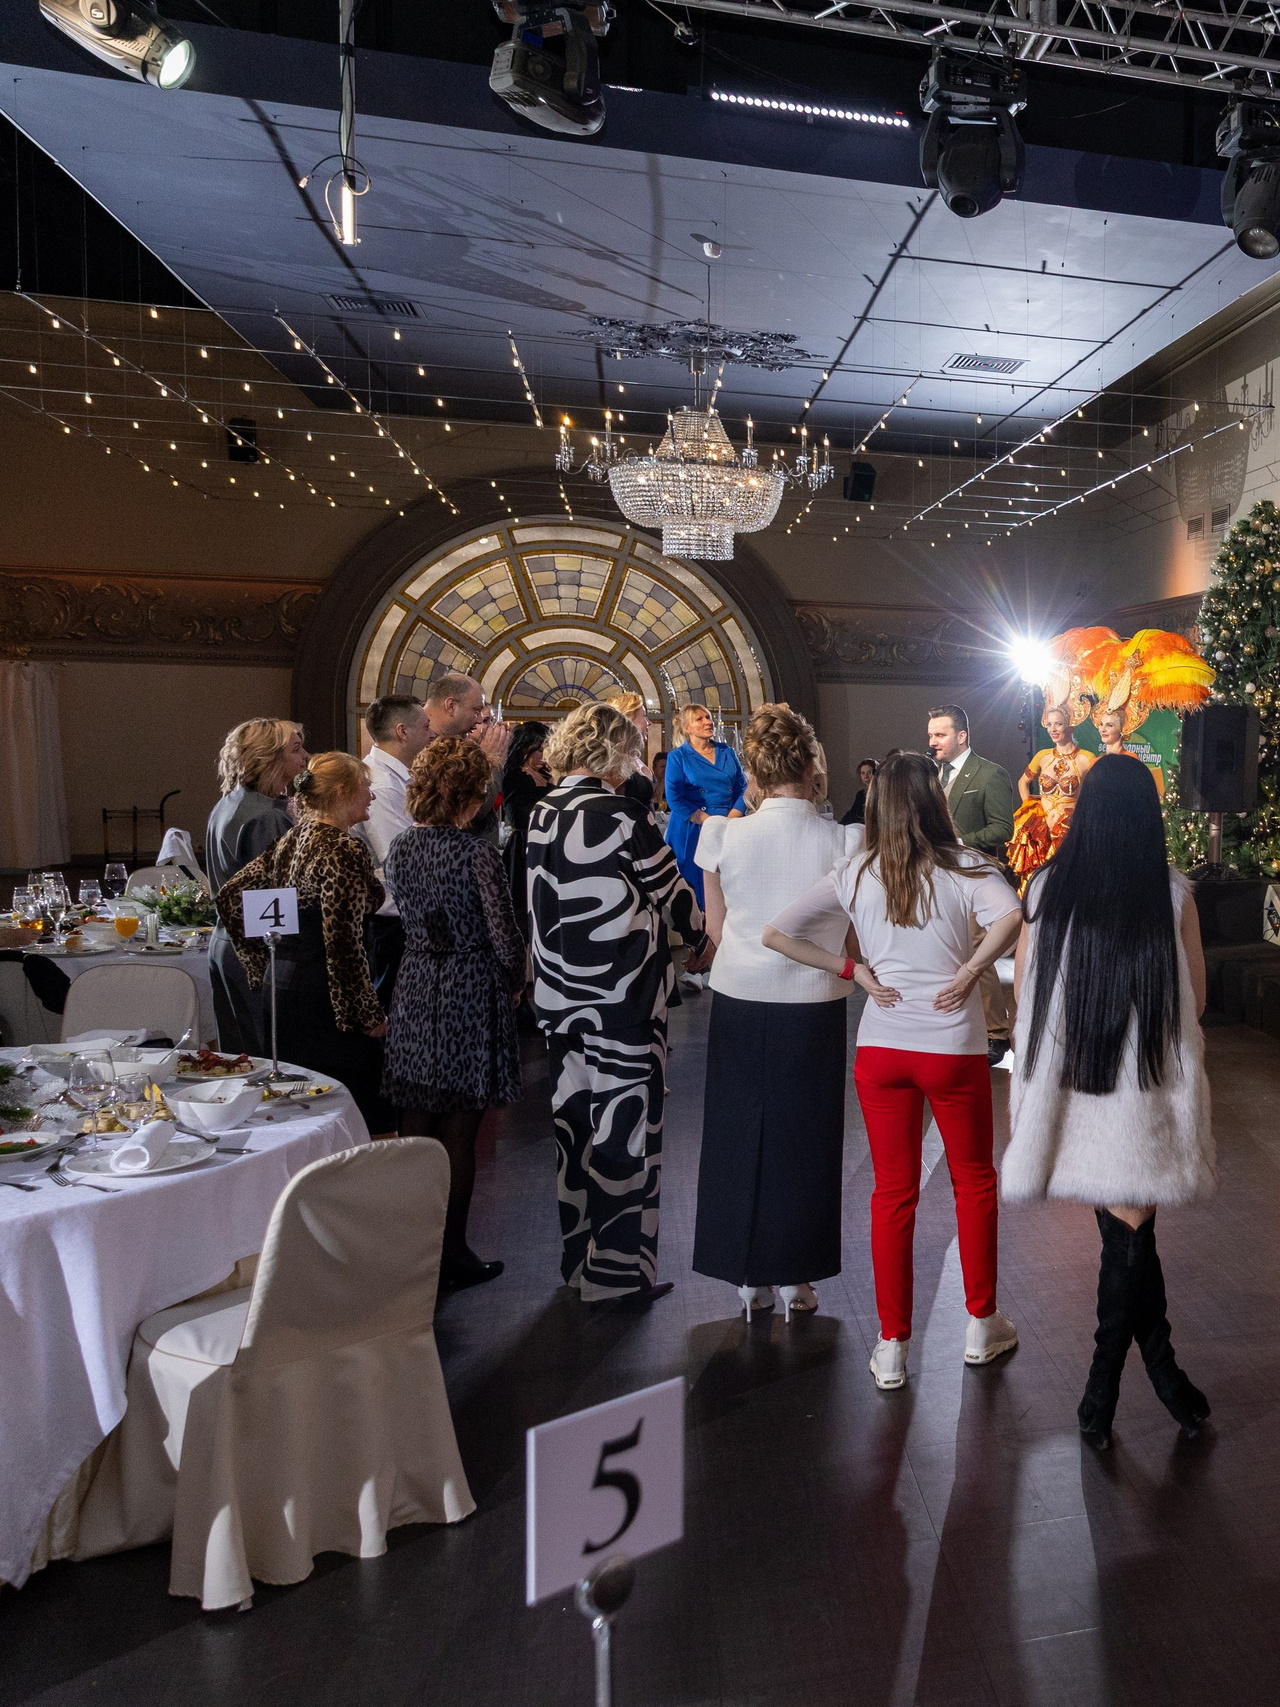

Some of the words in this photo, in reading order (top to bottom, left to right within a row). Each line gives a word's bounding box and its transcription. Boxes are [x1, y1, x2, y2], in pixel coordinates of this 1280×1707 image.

[1138, 753, 1162, 766] центр
[259, 897, 286, 928] 4
[581, 1416, 644, 1556] 5
